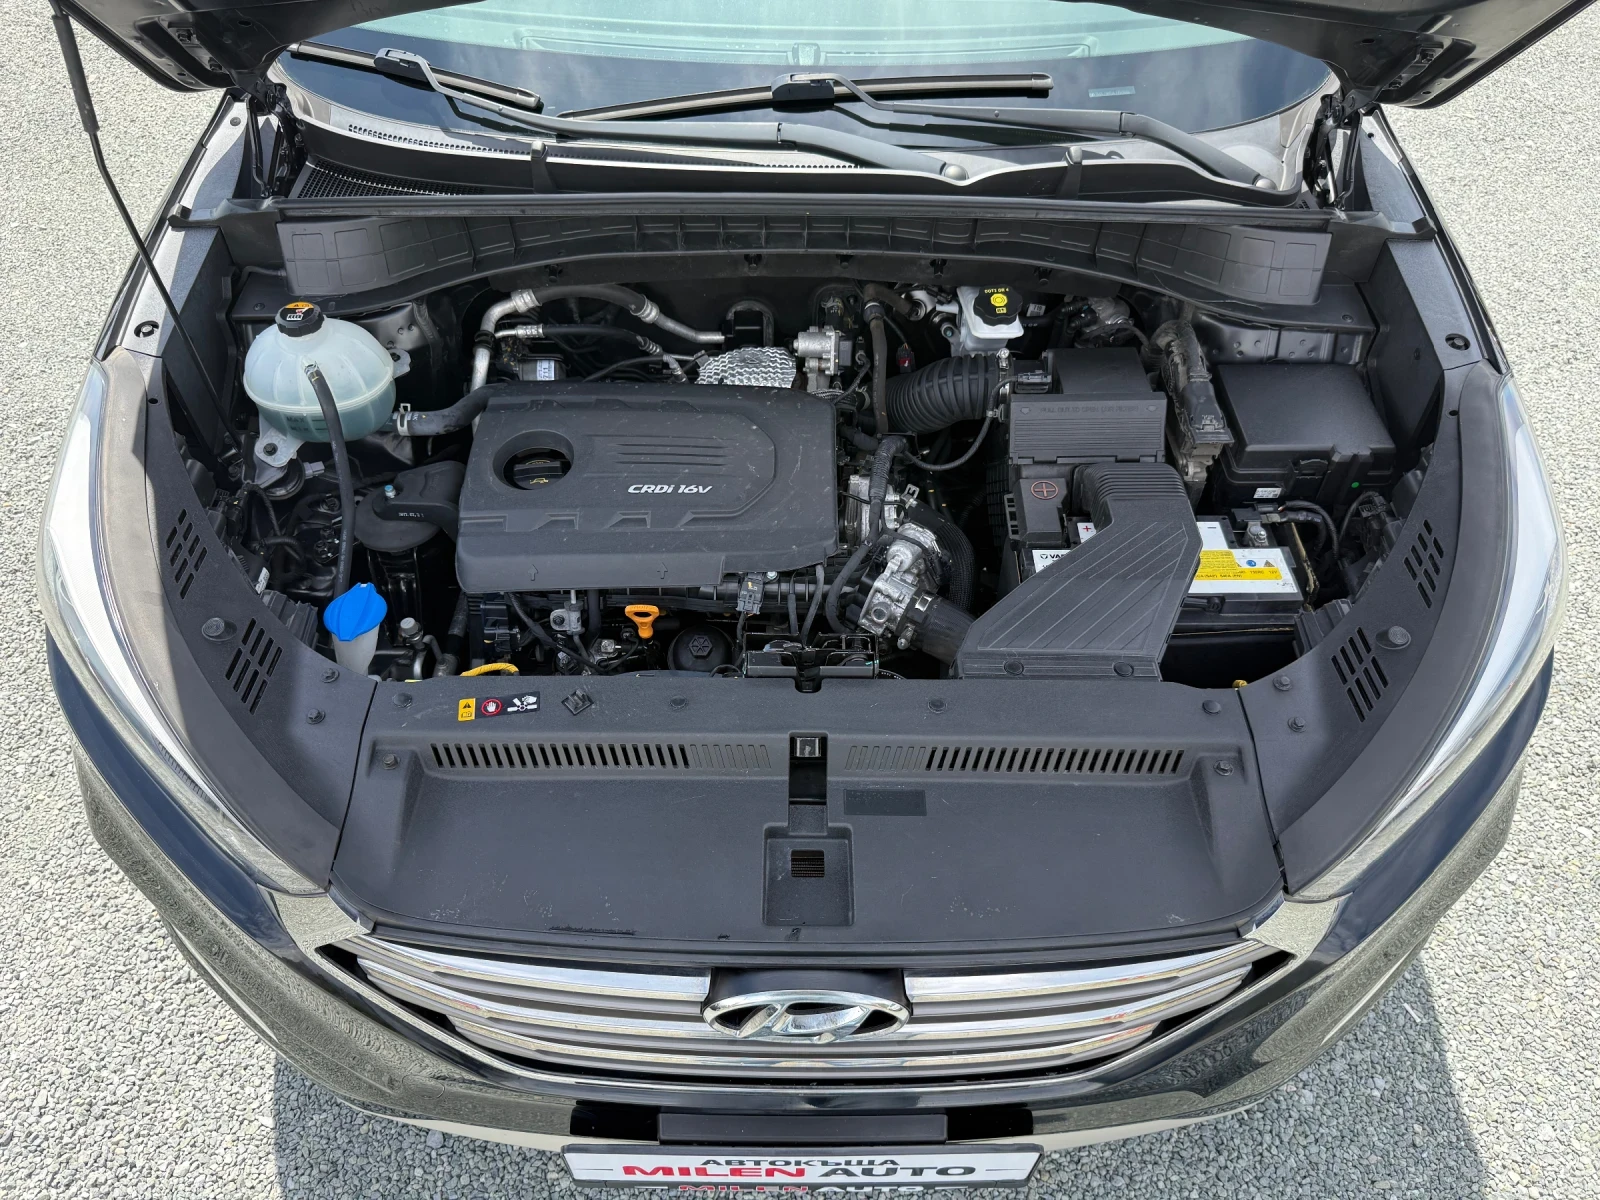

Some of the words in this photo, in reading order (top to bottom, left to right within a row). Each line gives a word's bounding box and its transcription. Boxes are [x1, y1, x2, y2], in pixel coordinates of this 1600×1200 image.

[627, 484, 676, 494] CRDi
[677, 484, 713, 494] 16V
[622, 1165, 805, 1178] MILEN
[818, 1166, 976, 1178] AUTO
